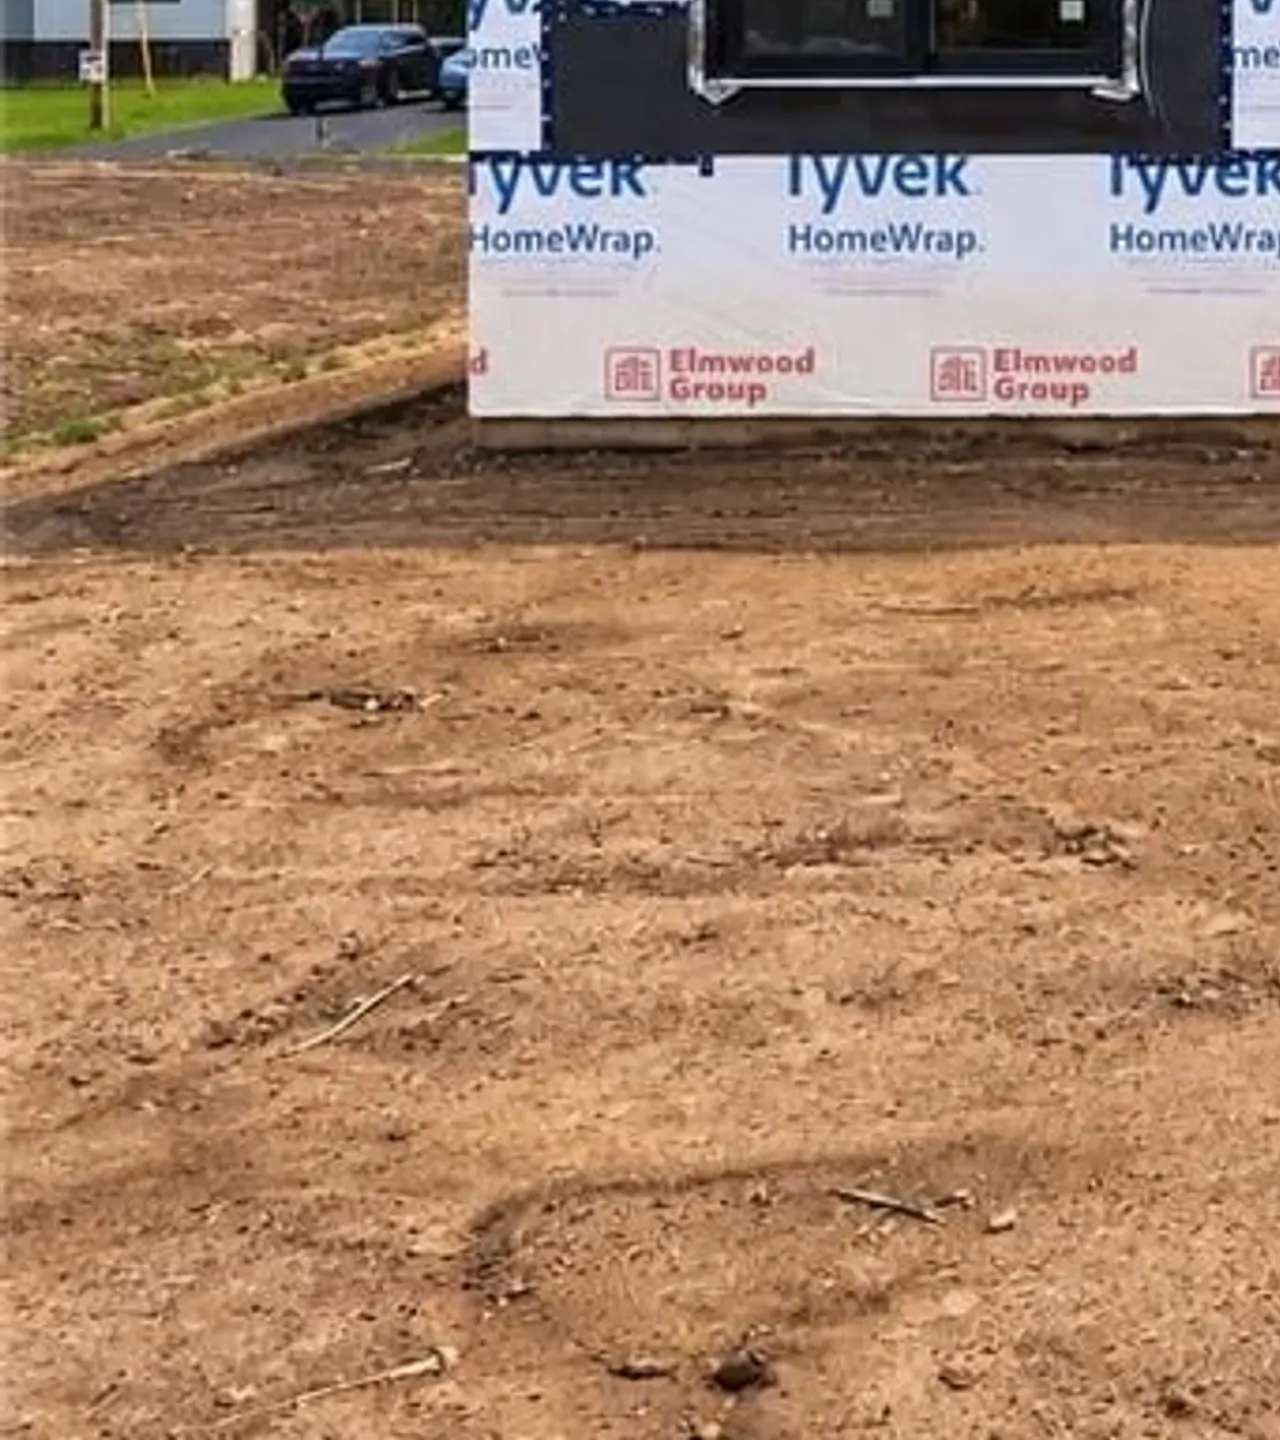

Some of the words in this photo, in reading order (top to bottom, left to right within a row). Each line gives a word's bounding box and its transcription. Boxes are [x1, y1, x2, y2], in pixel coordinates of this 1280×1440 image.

[670, 347, 815, 374] Elmwood
[994, 347, 1137, 373] Elmwood
[670, 376, 767, 407] Group
[994, 376, 1089, 407] Group
